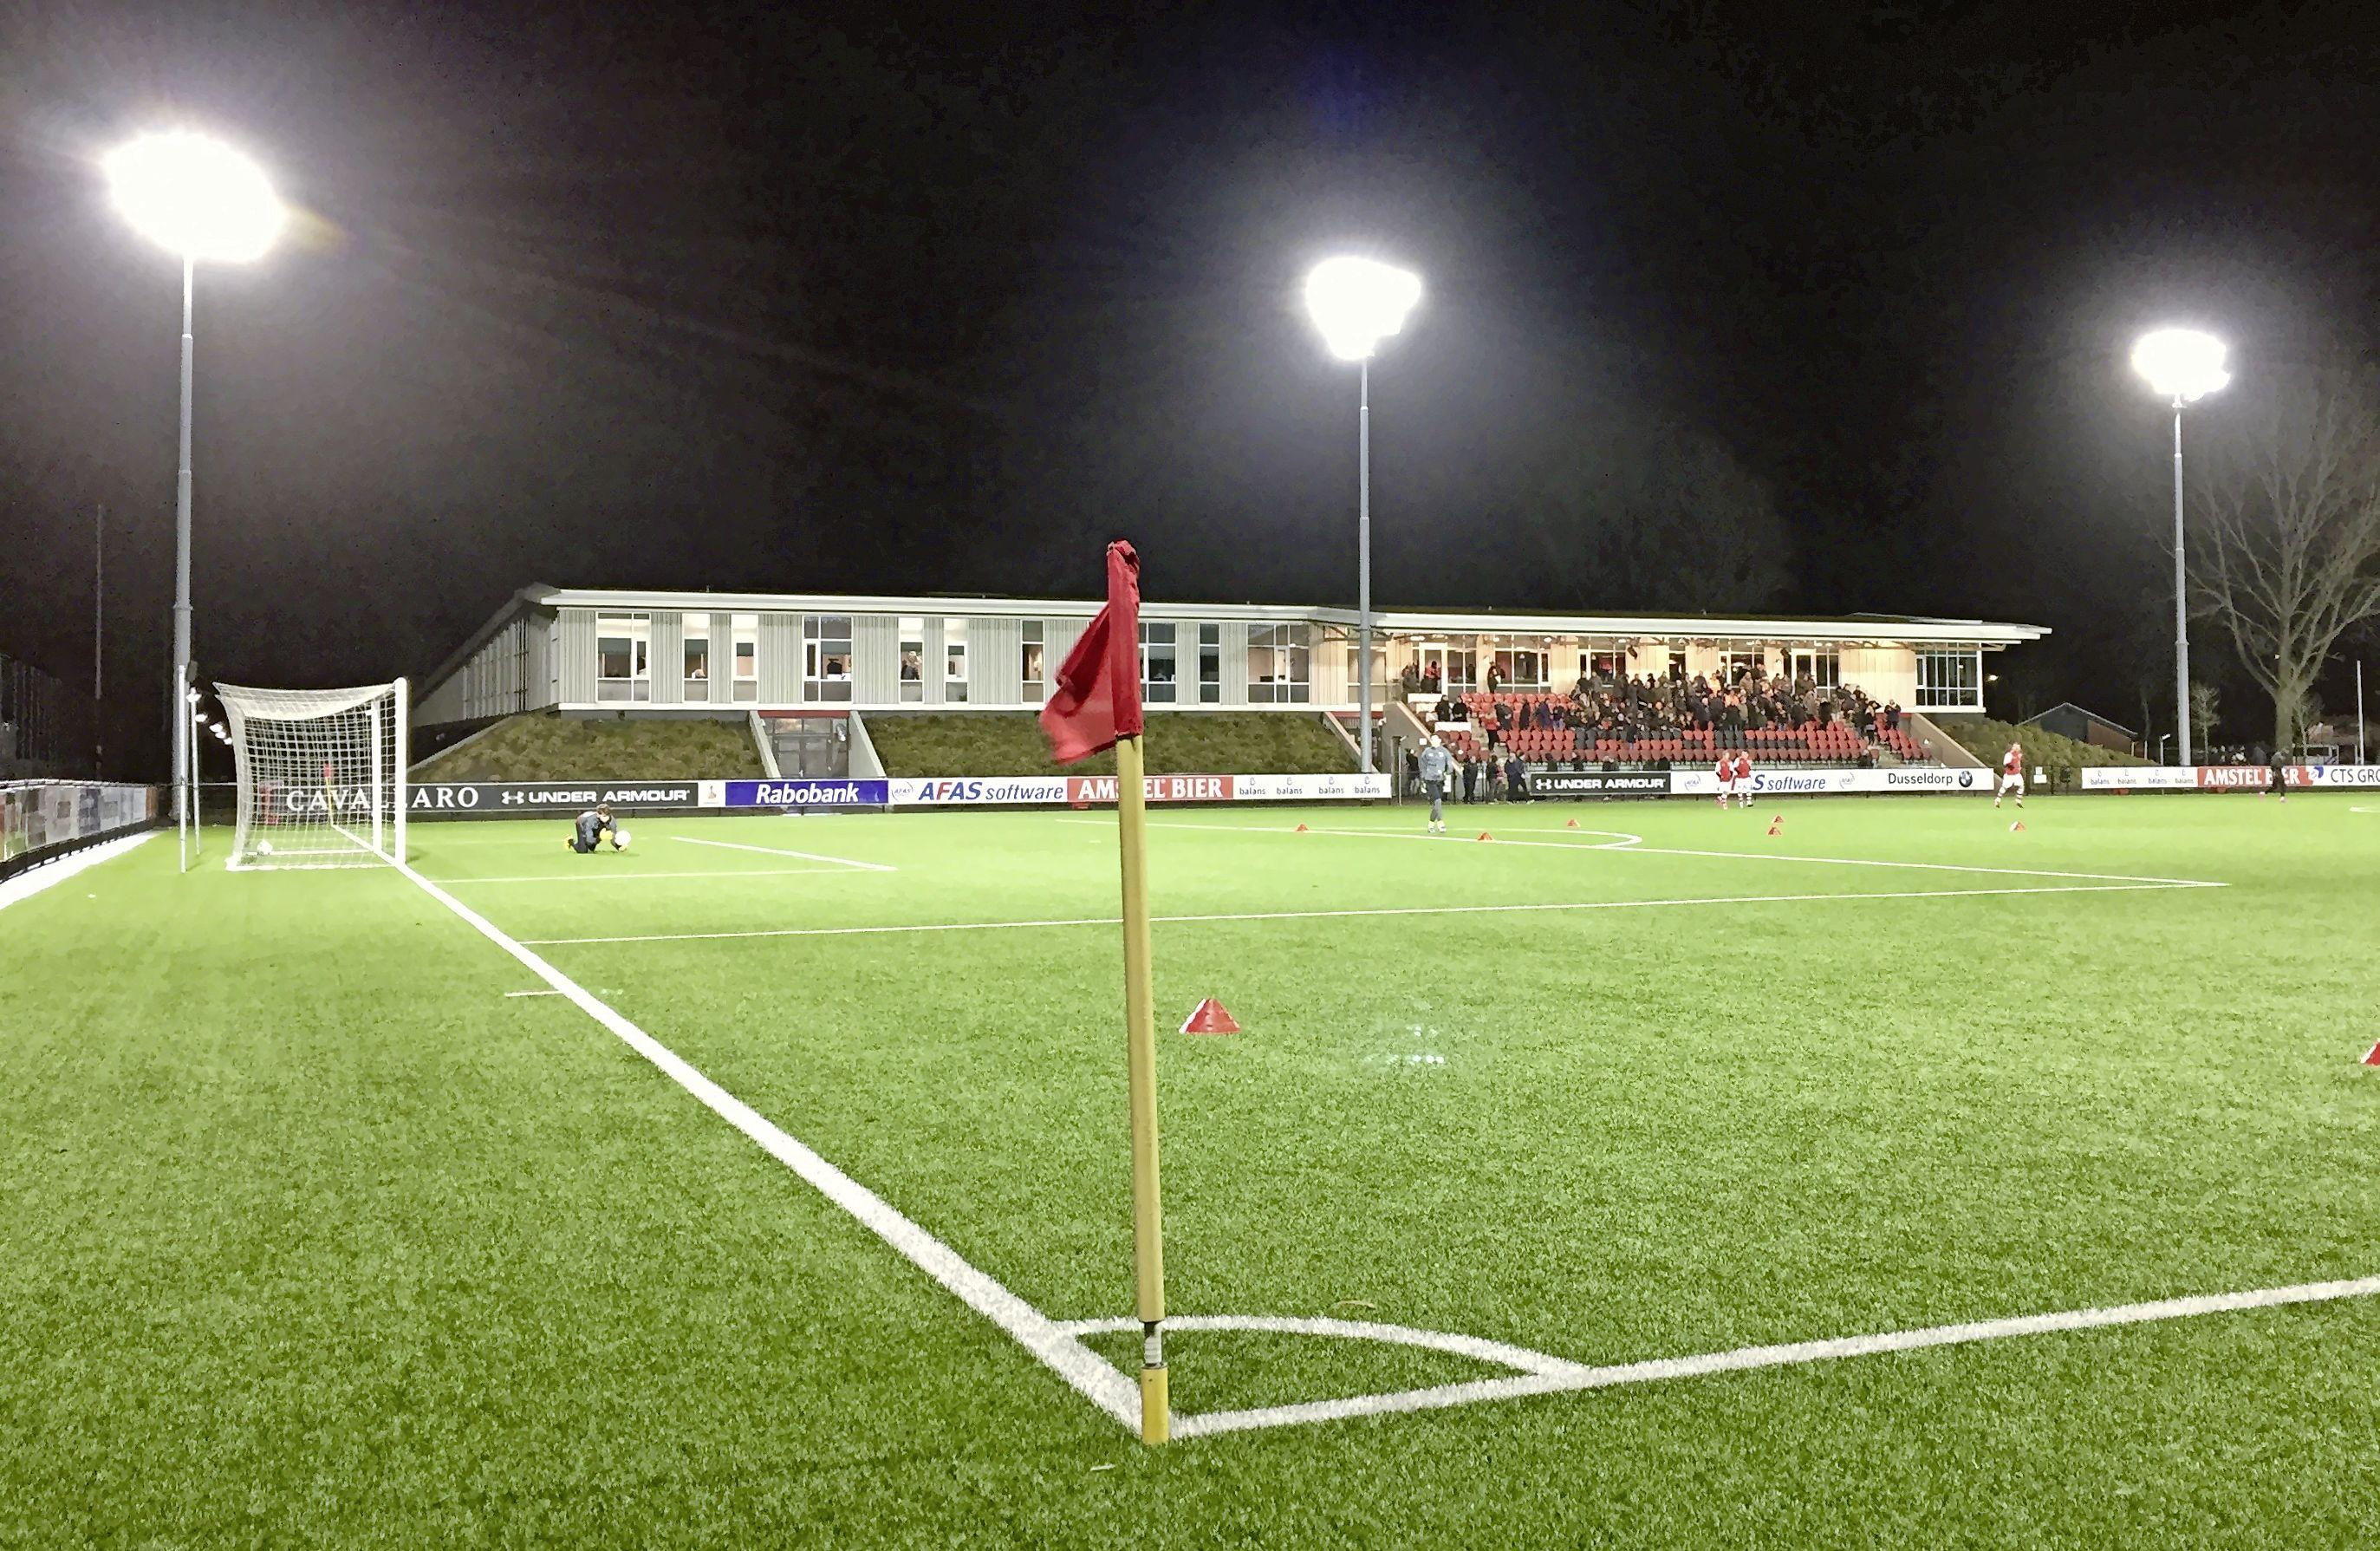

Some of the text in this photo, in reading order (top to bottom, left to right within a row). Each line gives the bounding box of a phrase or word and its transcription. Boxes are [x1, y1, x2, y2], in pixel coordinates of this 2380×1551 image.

[1888, 772, 1953, 787] Dusseldorp
[2203, 767, 2301, 785] AMSTEL BER
[2331, 768, 2354, 783] CTS
[918, 780, 1063, 801] AFAS software
[1077, 777, 1224, 799] AMEL BIER
[1239, 786, 1266, 796] balans
[1276, 786, 1303, 796] balans
[1318, 786, 1344, 795] balans
[1354, 785, 1381, 794] balans
[1553, 778, 1666, 790] UNDER ARMOUR
[1767, 776, 1826, 791] software
[285, 786, 479, 811] CAVAARO
[528, 789, 691, 804] UNDER ARMOUR
[756, 782, 859, 805] Rabobank
